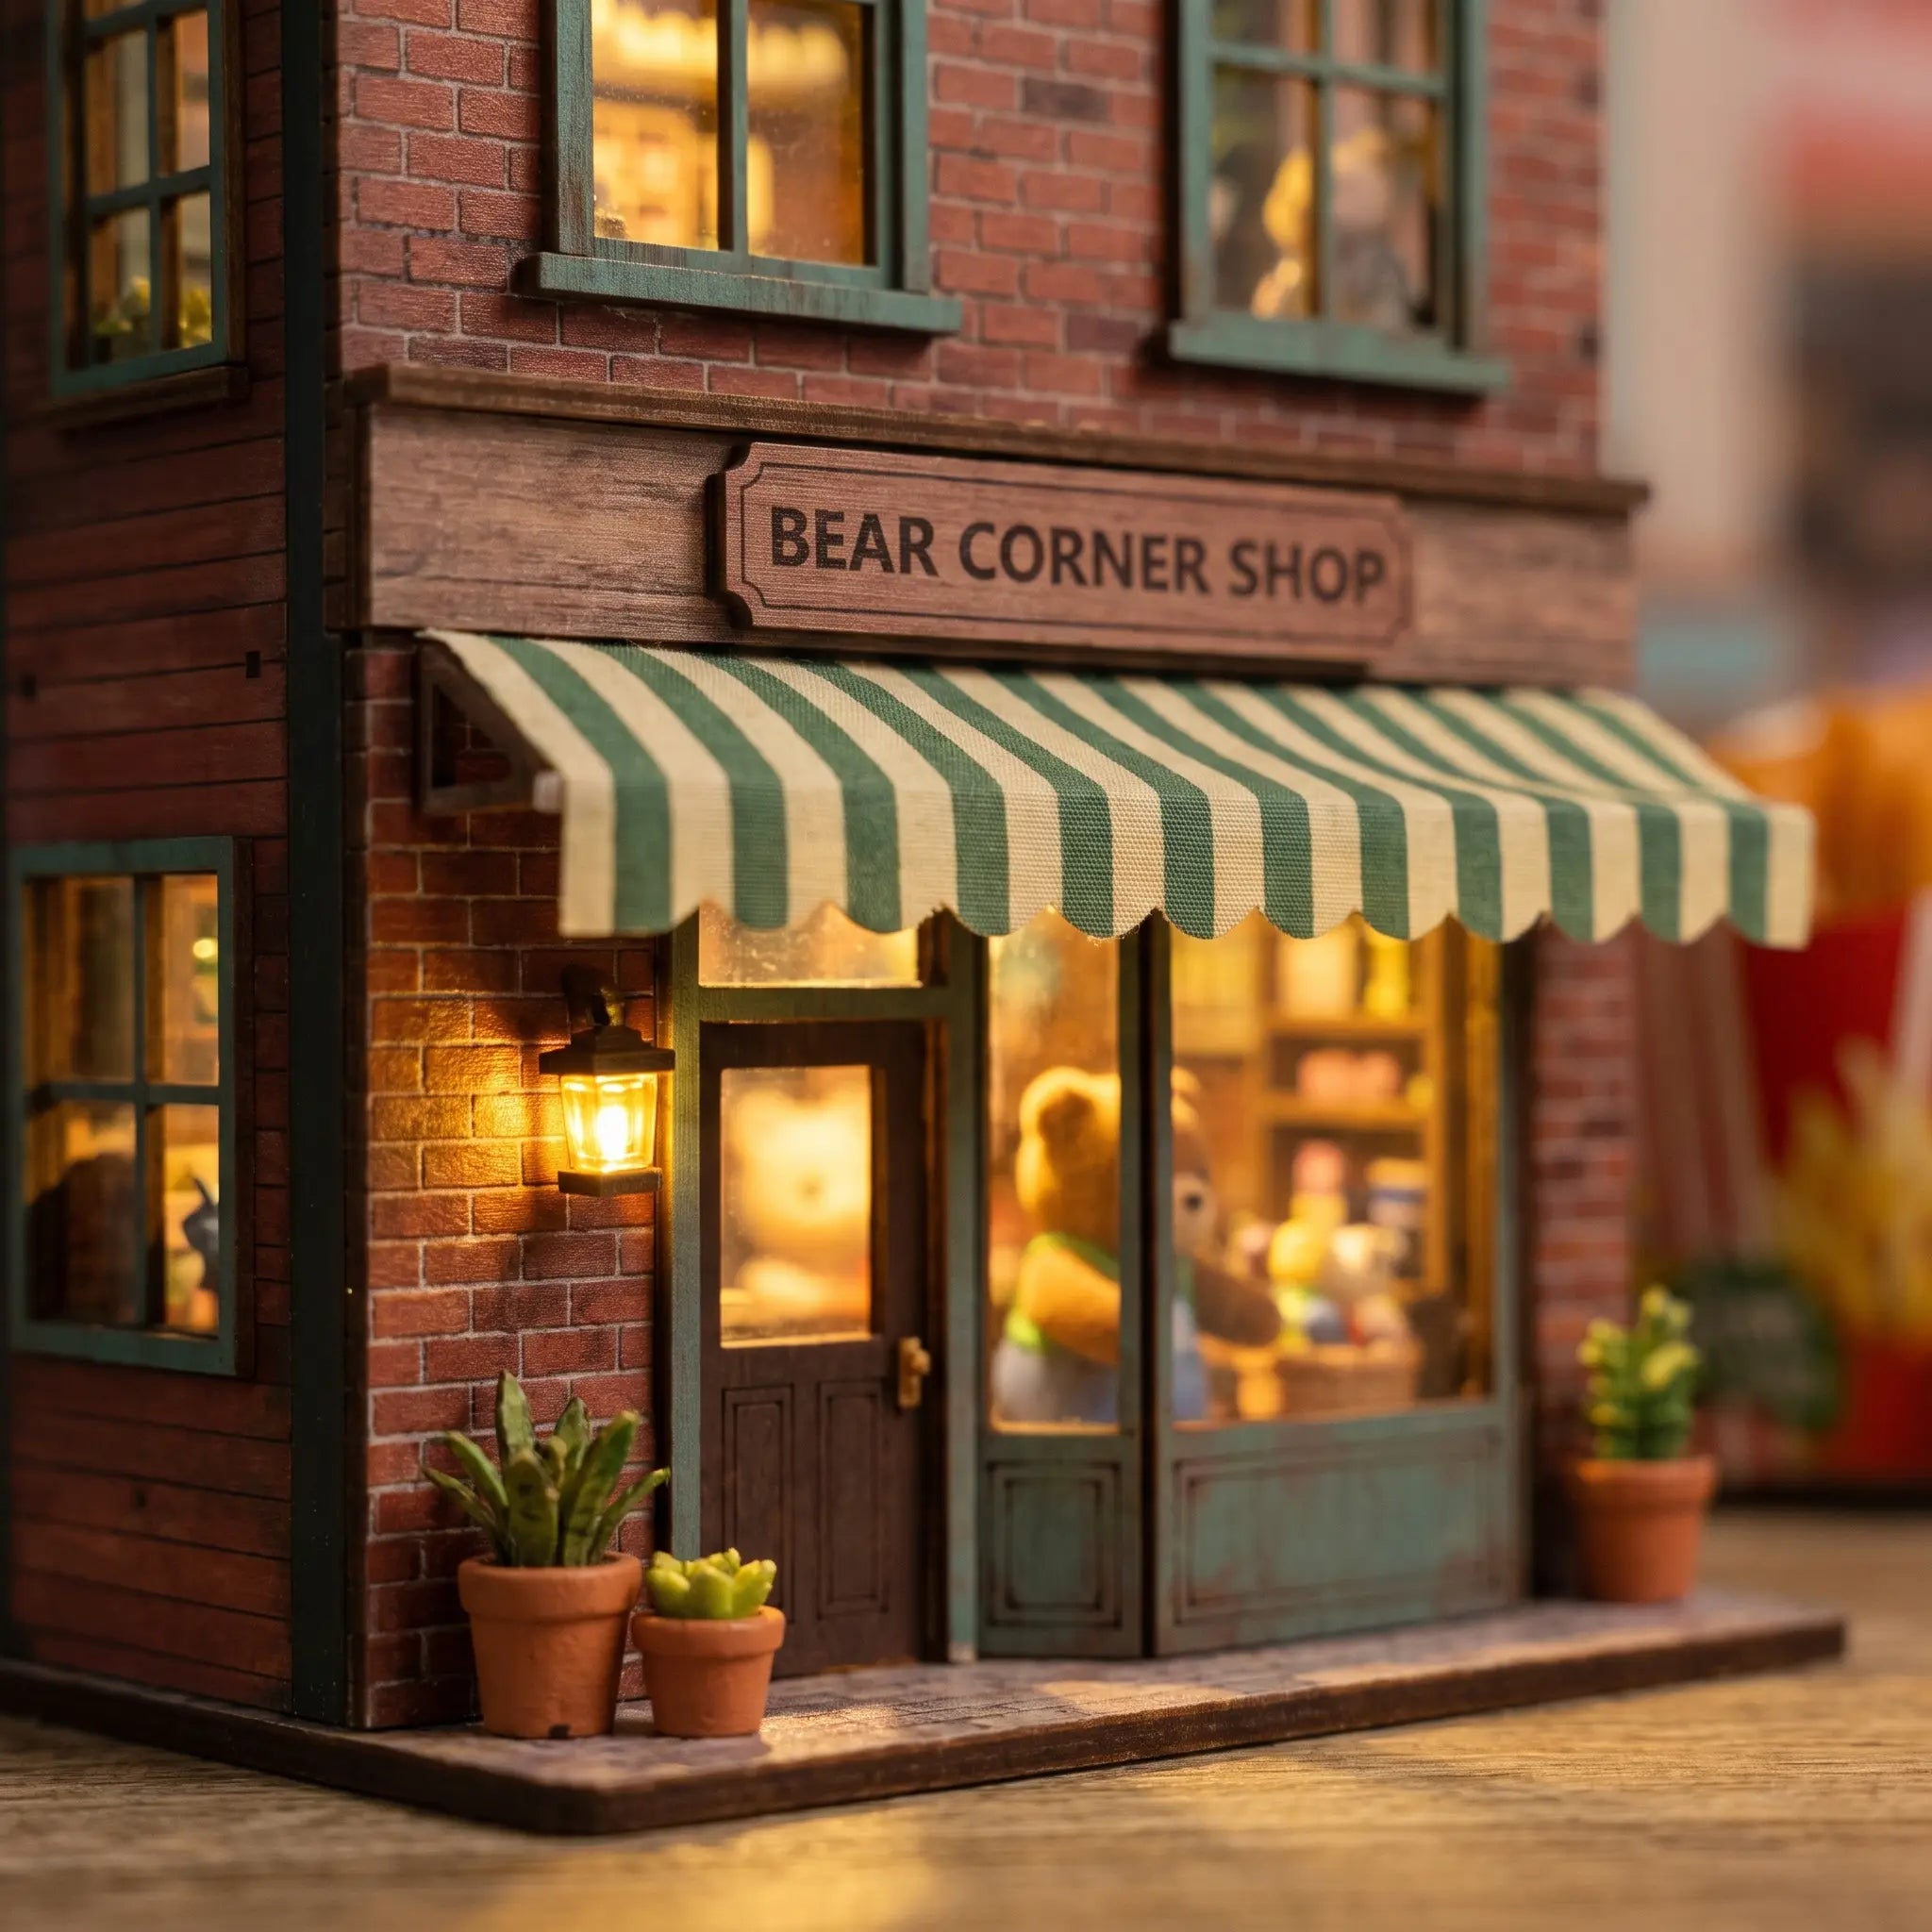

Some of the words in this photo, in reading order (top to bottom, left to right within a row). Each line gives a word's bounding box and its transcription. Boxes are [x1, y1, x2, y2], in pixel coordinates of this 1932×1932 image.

[770, 507, 939, 578] BEAR
[959, 523, 1210, 594] CORNER
[1227, 541, 1386, 605] SHOP
